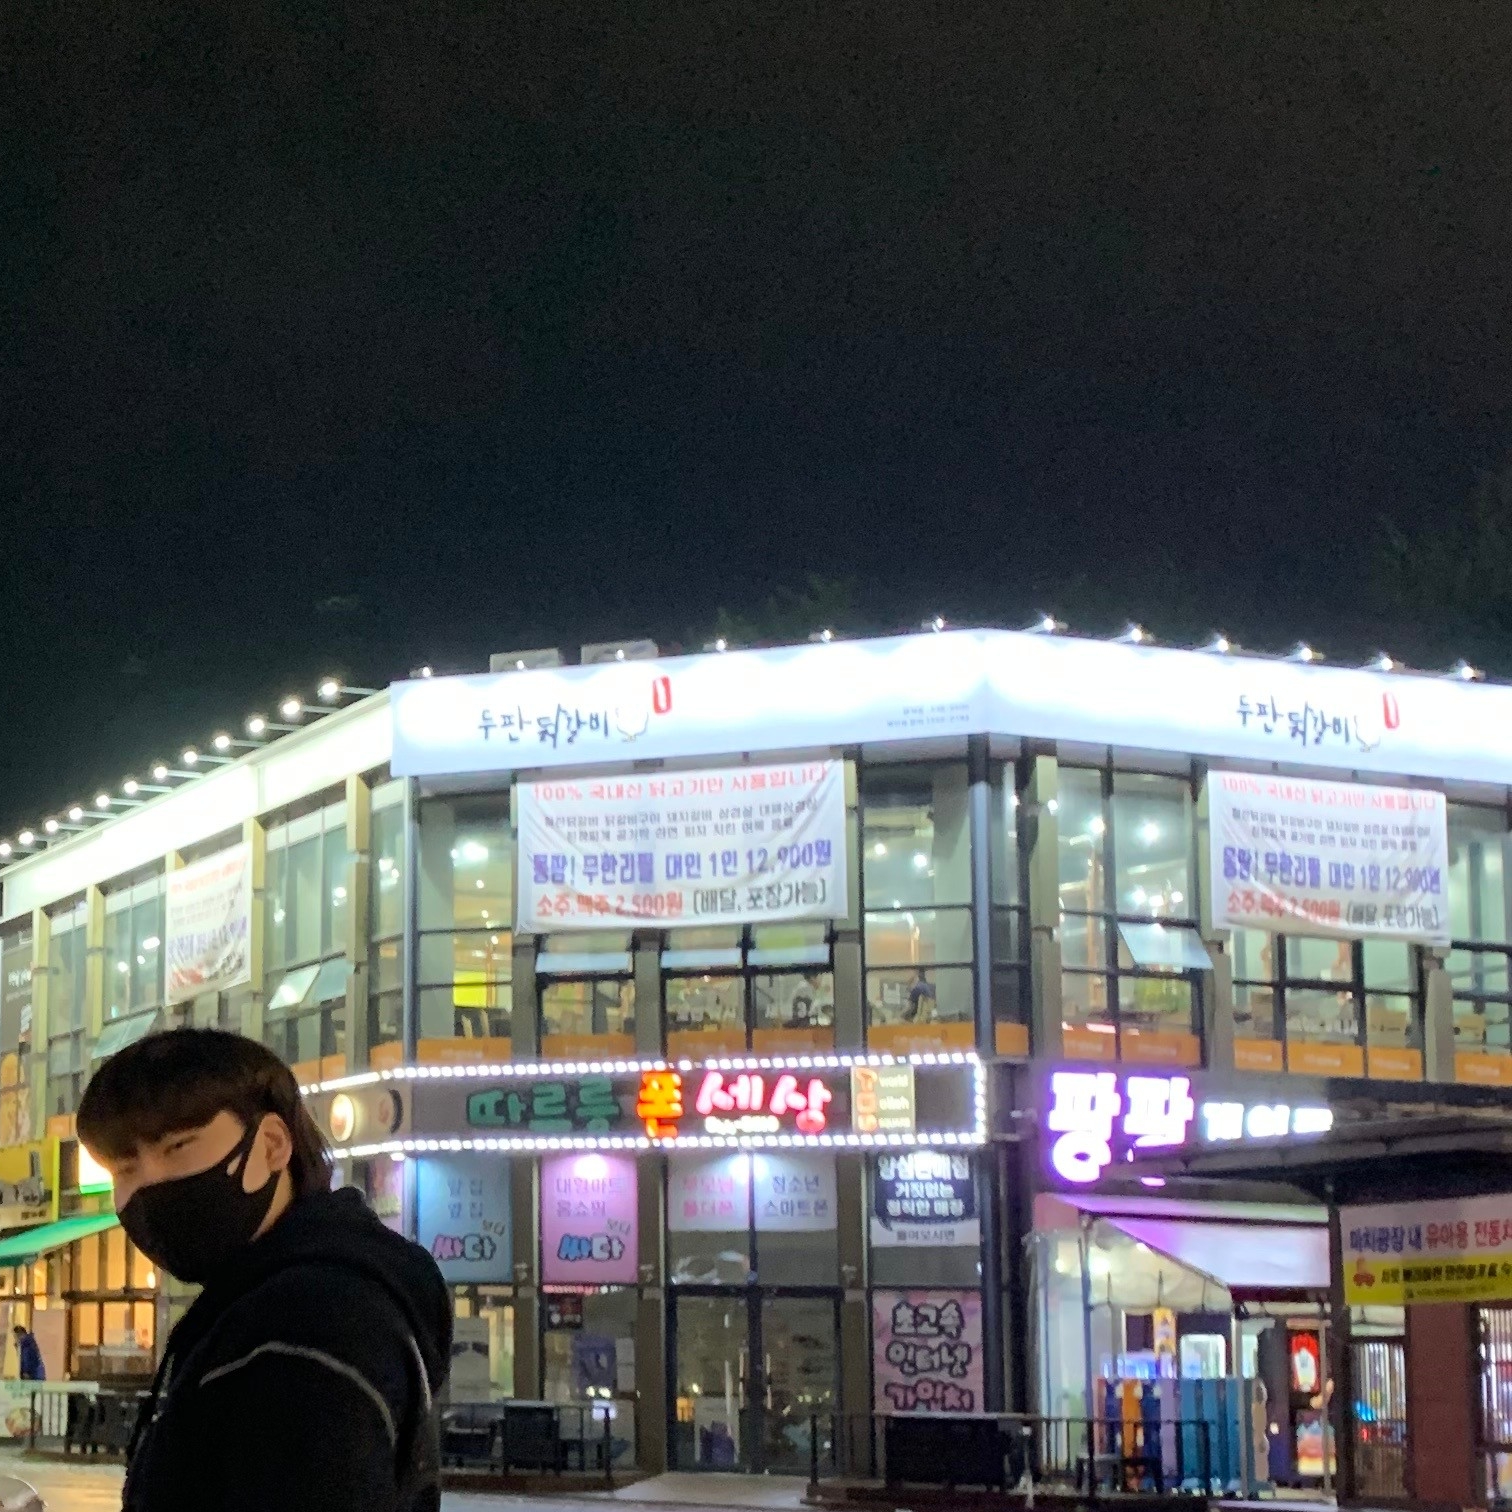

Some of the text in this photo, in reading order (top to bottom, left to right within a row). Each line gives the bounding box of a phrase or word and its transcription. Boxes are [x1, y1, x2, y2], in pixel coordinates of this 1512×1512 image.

[533, 782, 583, 802] 100%
[591, 780, 642, 800] 국내산
[648, 775, 724, 798] 닭고기만
[583, 851, 655, 885] 무한리필
[665, 851, 702, 881] 대인
[709, 850, 738, 878] 1인
[466, 1073, 621, 1134] 따르릉
[773, 1174, 820, 1194] 청소년
[895, 1181, 955, 1199] 거짓없는
[556, 1200, 607, 1217] 홈쇼핑
[764, 1199, 829, 1218] 스마트폰
[886, 1198, 966, 1217] 정직한 매장
[431, 1232, 497, 1262] 싸다
[556, 1232, 626, 1262] 싸다
[1426, 1220, 1468, 1250] 유아용
[892, 1299, 965, 1339] 초고속
[885, 1340, 972, 1378] 인터넷
